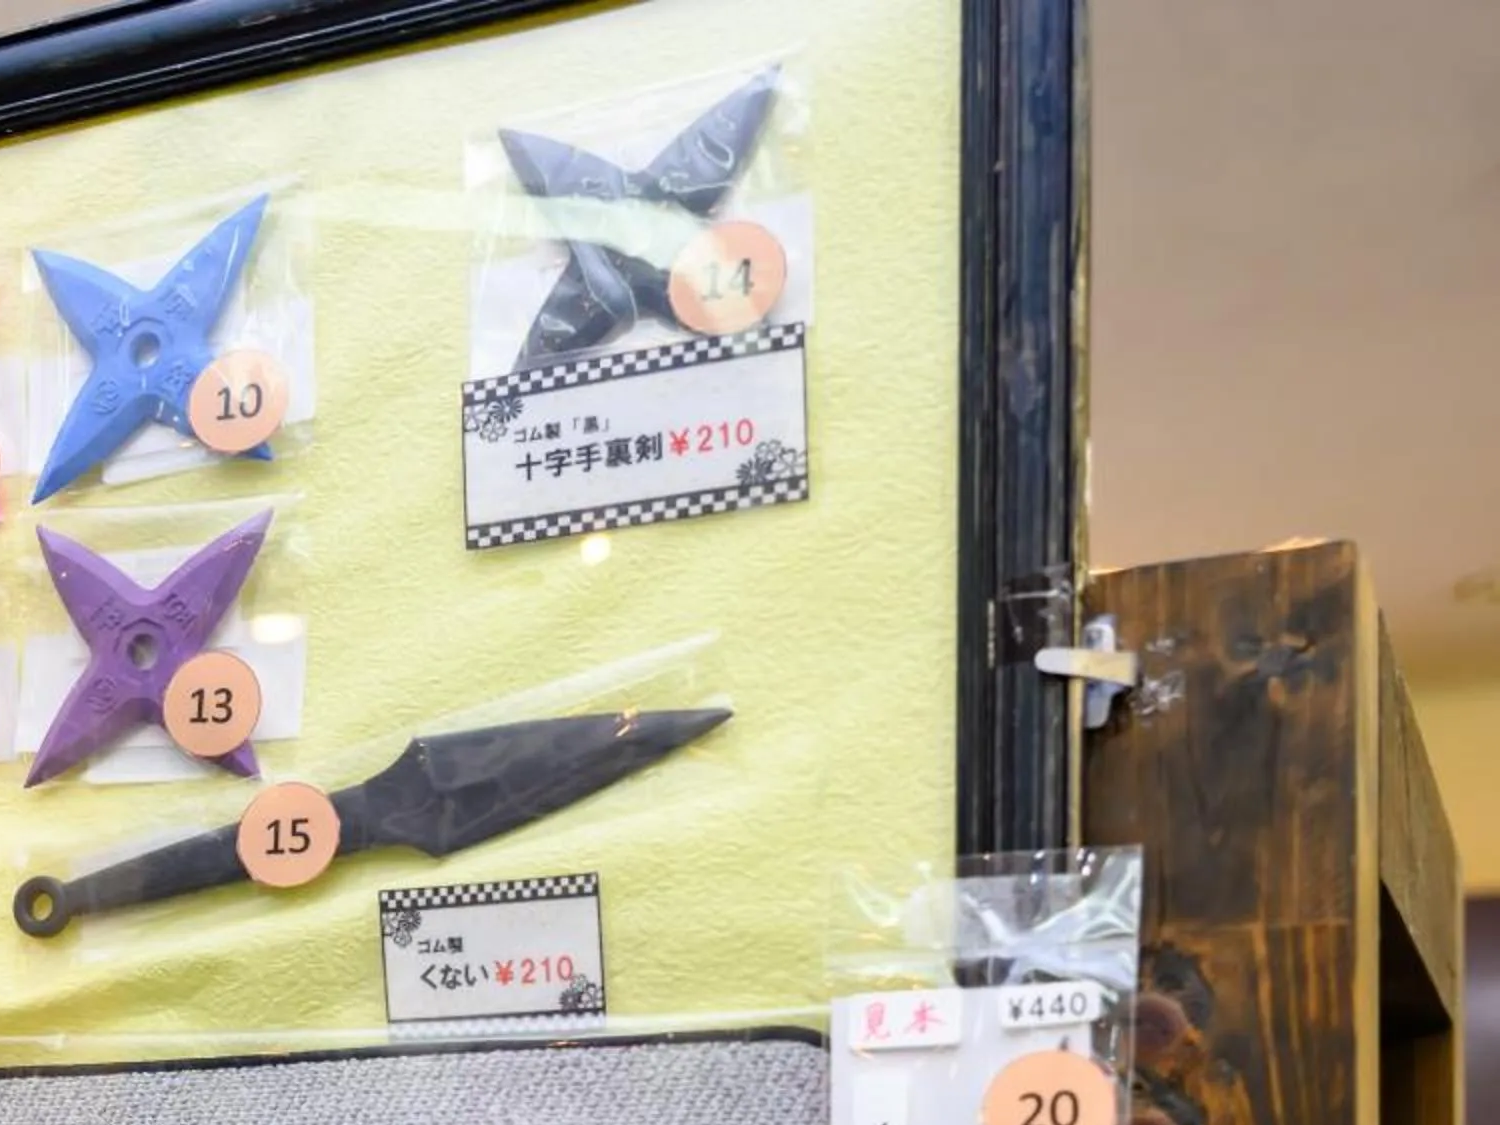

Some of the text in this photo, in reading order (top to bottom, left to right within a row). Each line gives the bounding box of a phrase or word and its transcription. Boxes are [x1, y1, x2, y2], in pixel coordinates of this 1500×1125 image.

[701, 257, 754, 300] 14
[216, 383, 263, 421] 10
[189, 687, 233, 723] 13
[265, 818, 311, 855] 15
[417, 936, 463, 954] ゴム製
[861, 1001, 947, 1041] 見本
[1008, 992, 1088, 1021] ¥440
